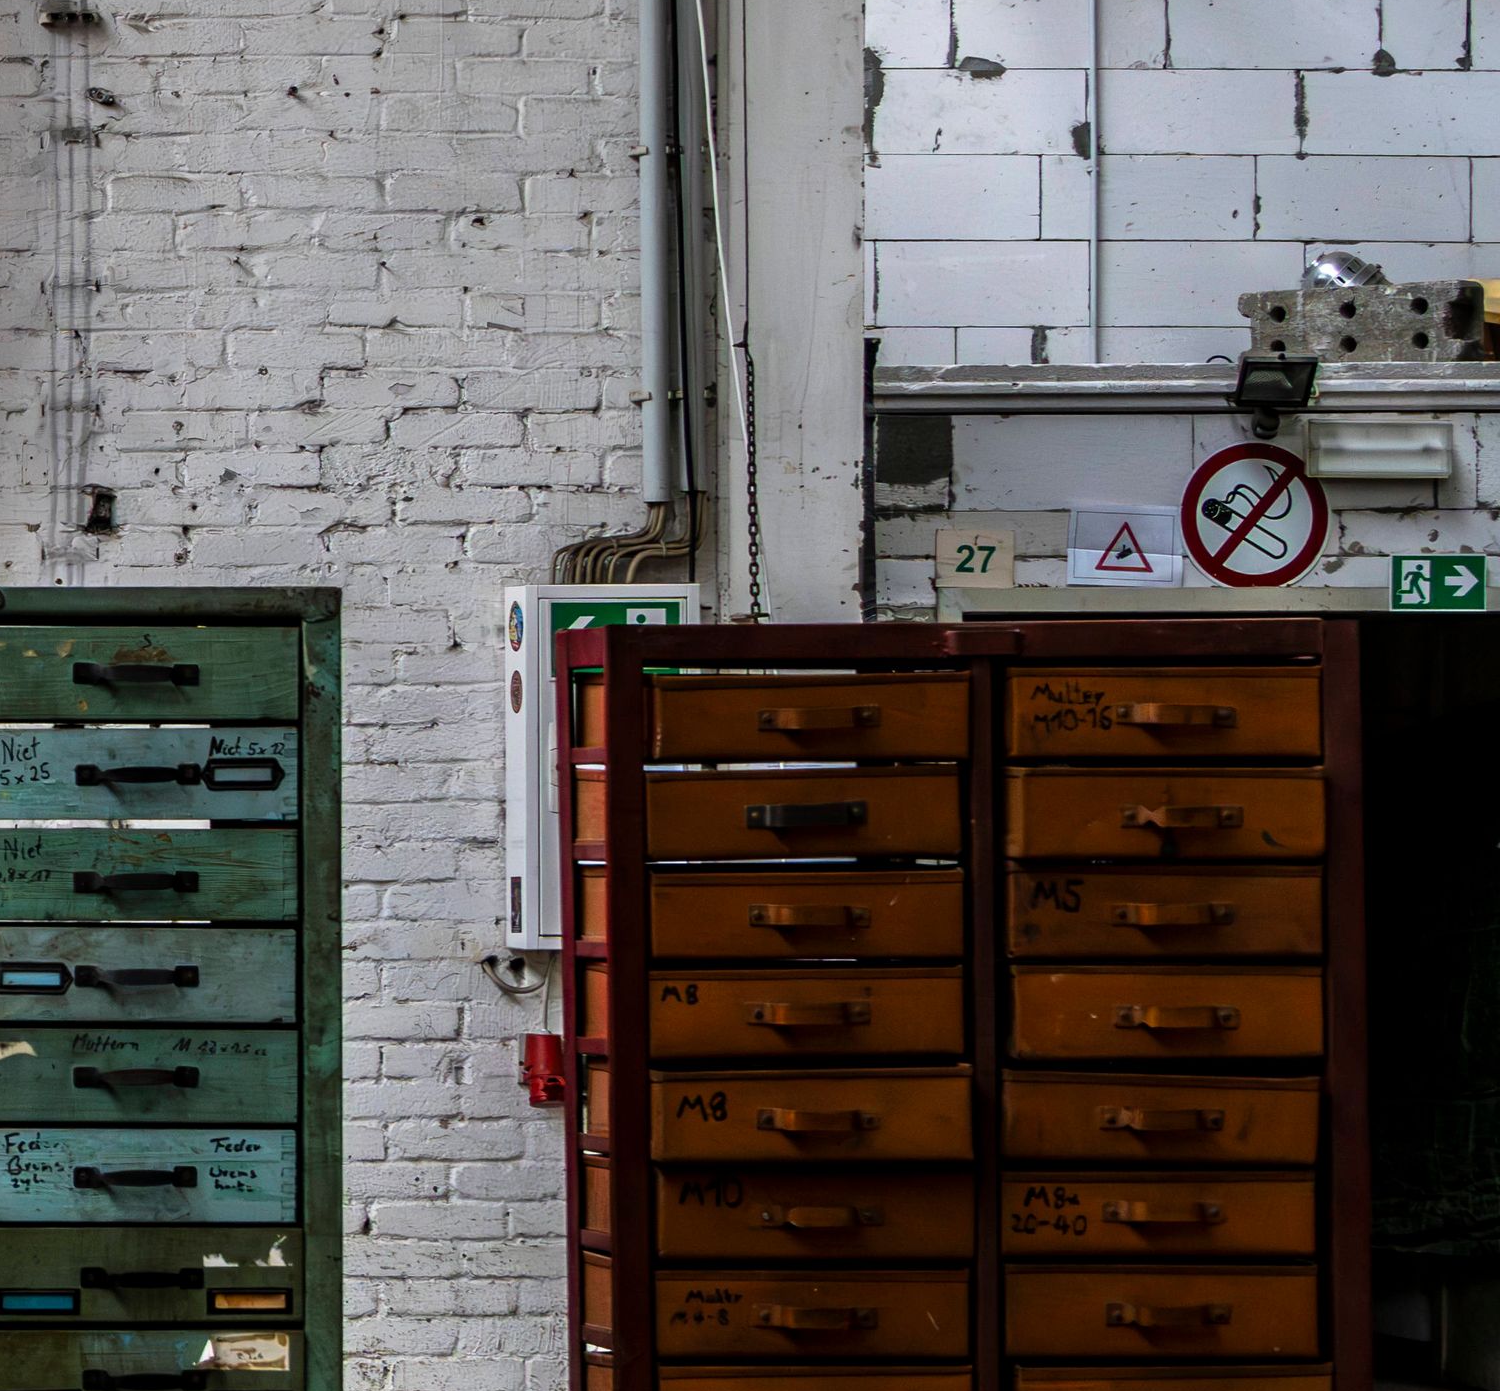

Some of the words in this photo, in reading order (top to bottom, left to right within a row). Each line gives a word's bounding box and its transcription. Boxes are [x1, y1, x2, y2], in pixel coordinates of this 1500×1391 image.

[955, 545, 997, 574] 27
[1, 737, 41, 765] Niet
[3, 834, 43, 861] Niet
[1031, 879, 1085, 913] M5
[660, 983, 699, 1005] M8
[676, 1091, 728, 1122] M8
[678, 1176, 744, 1209] M10
